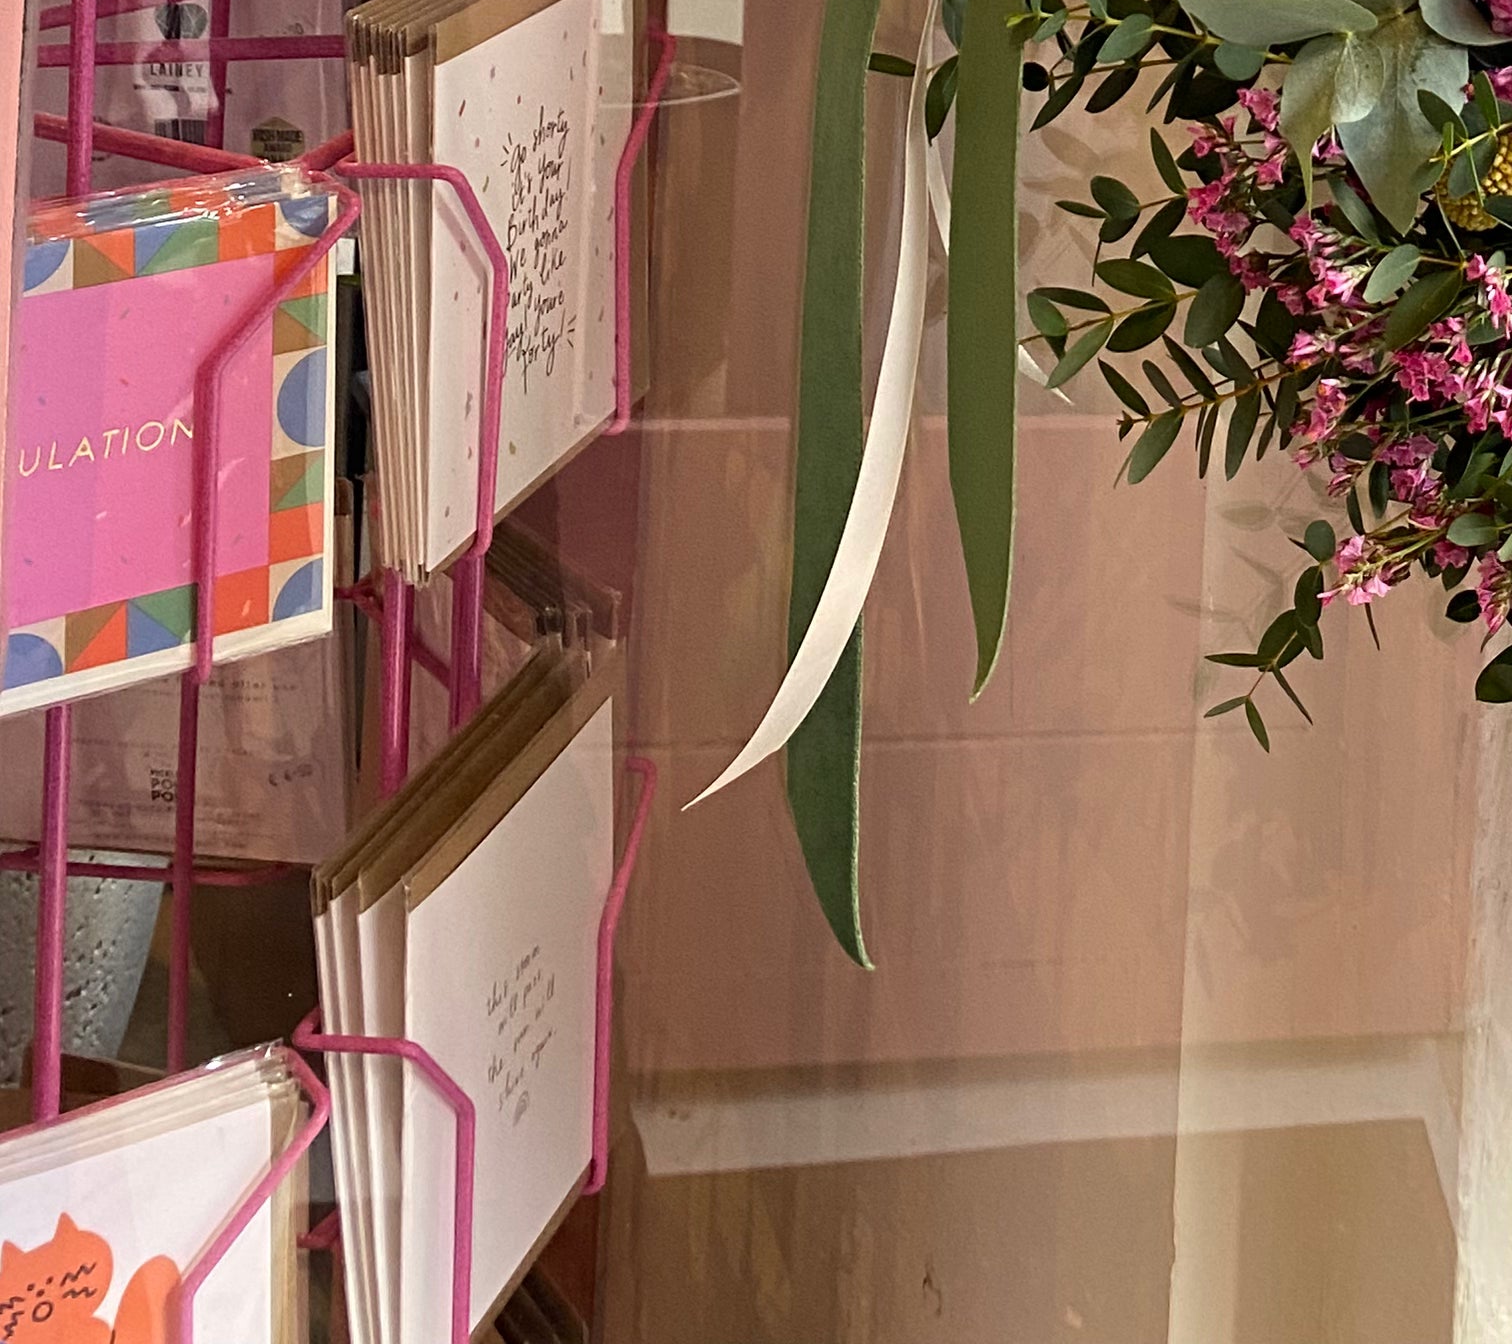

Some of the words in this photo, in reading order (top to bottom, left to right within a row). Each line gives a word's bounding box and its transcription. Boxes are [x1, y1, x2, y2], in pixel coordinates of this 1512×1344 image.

[150, 62, 205, 78] LAINEY
[532, 105, 570, 159] shorty
[538, 153, 564, 194] your
[508, 273, 533, 310] arty
[540, 246, 567, 286] like
